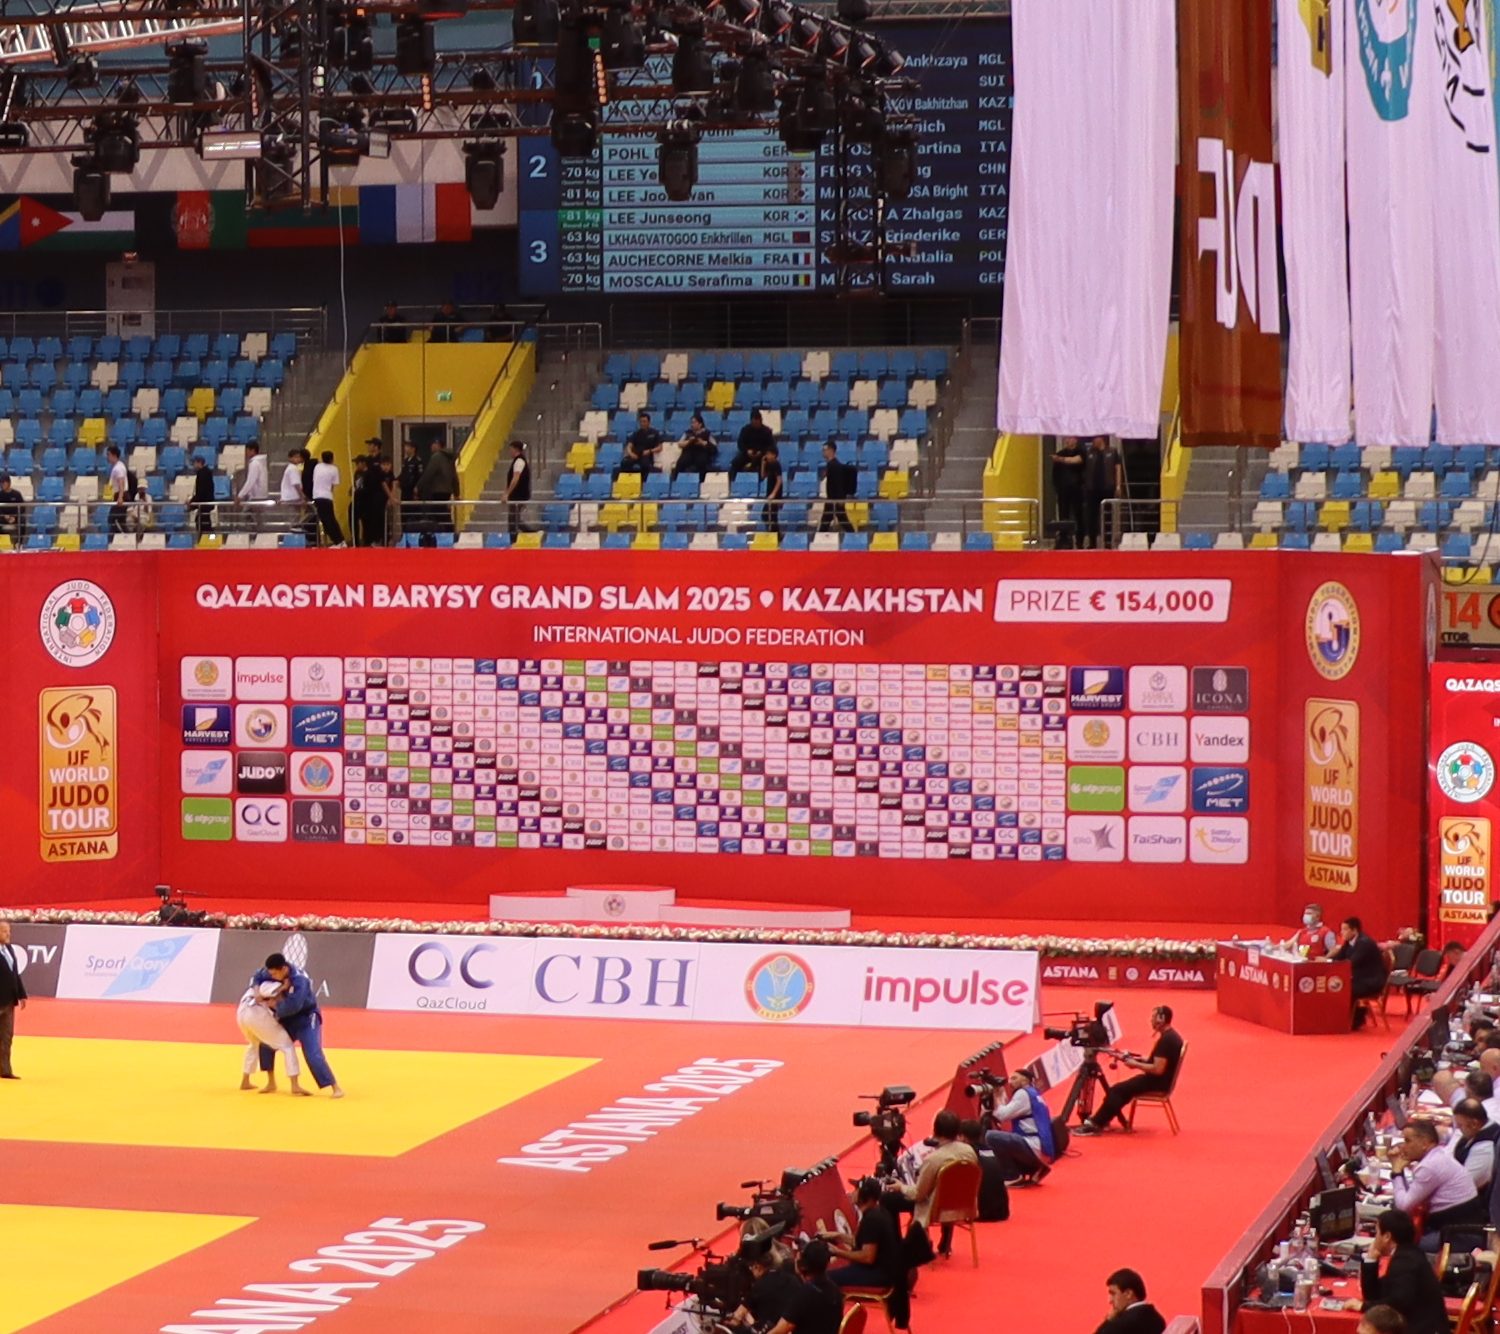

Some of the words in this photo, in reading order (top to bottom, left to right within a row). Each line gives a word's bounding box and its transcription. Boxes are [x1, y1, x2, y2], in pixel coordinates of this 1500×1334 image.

[979, 54, 1005, 64] MGL
[979, 76, 1004, 86] SUI
[979, 98, 1006, 107] KAZ
[979, 121, 1005, 130] MGL
[763, 146, 789, 157] GER
[980, 142, 1006, 152] ITA
[608, 149, 649, 160] POHL
[530, 156, 547, 178] 2
[763, 167, 789, 177] KOR
[979, 163, 1006, 173] CHN
[609, 170, 635, 180] LEE
[609, 191, 635, 201] LEE
[763, 189, 789, 199] KOR
[933, 185, 968, 197] Bright
[980, 185, 1006, 195] ITA
[609, 213, 635, 224] LEE
[639, 213, 711, 226] Junseong
[763, 211, 789, 221] KOR
[903, 208, 963, 222] Zhalgas
[979, 207, 1006, 217] KAZ
[763, 232, 788, 243] MGL
[530, 240, 547, 262] 3
[609, 254, 705, 266] AUCHECORNE
[763, 254, 789, 264] FRA
[609, 276, 683, 287] MOSCALU
[763, 275, 789, 285] ROU
[892, 273, 934, 284] Sarah
[196, 584, 364, 609] QAZAQSTAN
[372, 585, 484, 609] BARYSY
[491, 586, 593, 610] GRAND
[600, 587, 679, 609] SLAM
[686, 587, 751, 611] 2025
[782, 588, 983, 613] KAZAKHSTAN
[1010, 590, 1080, 611] PRIZE
[1116, 591, 1214, 615] 154,000
[533, 625, 682, 644] INTERNATIONAL
[686, 627, 741, 645] JUDO
[746, 628, 864, 647] FEDERATION
[237, 671, 284, 685] impulse
[1136, 732, 1179, 747] CBH
[1195, 734, 1244, 747] Yandex
[67, 750, 90, 766] IJF
[49, 767, 109, 783] WORLD
[49, 785, 109, 808] JUDO
[1310, 785, 1353, 806] WORLD
[49, 808, 110, 831] TOUR
[1310, 807, 1353, 831] JUDO
[1132, 834, 1182, 844] TaiShan
[1309, 830, 1353, 856] TOUR
[48, 842, 109, 856] ASTANA
[1309, 867, 1351, 886] ASTANA
[1444, 866, 1485, 876] WORLD
[1444, 877, 1485, 891] JUDO
[1444, 890, 1485, 905] TOUR
[85, 954, 126, 972] Sport
[408, 942, 498, 989] QC
[1043, 966, 1099, 979] ASTANA
[1148, 969, 1204, 982] ASTANA
[1239, 966, 1269, 986] ASTANA
[534, 954, 695, 1009] CBH
[863, 967, 1029, 1013] impulse
[416, 996, 487, 1012] QazCloud
[497, 1096, 701, 1173] ASTANA
[644, 1056, 785, 1096] 2025
[288, 1216, 487, 1277] 2025
